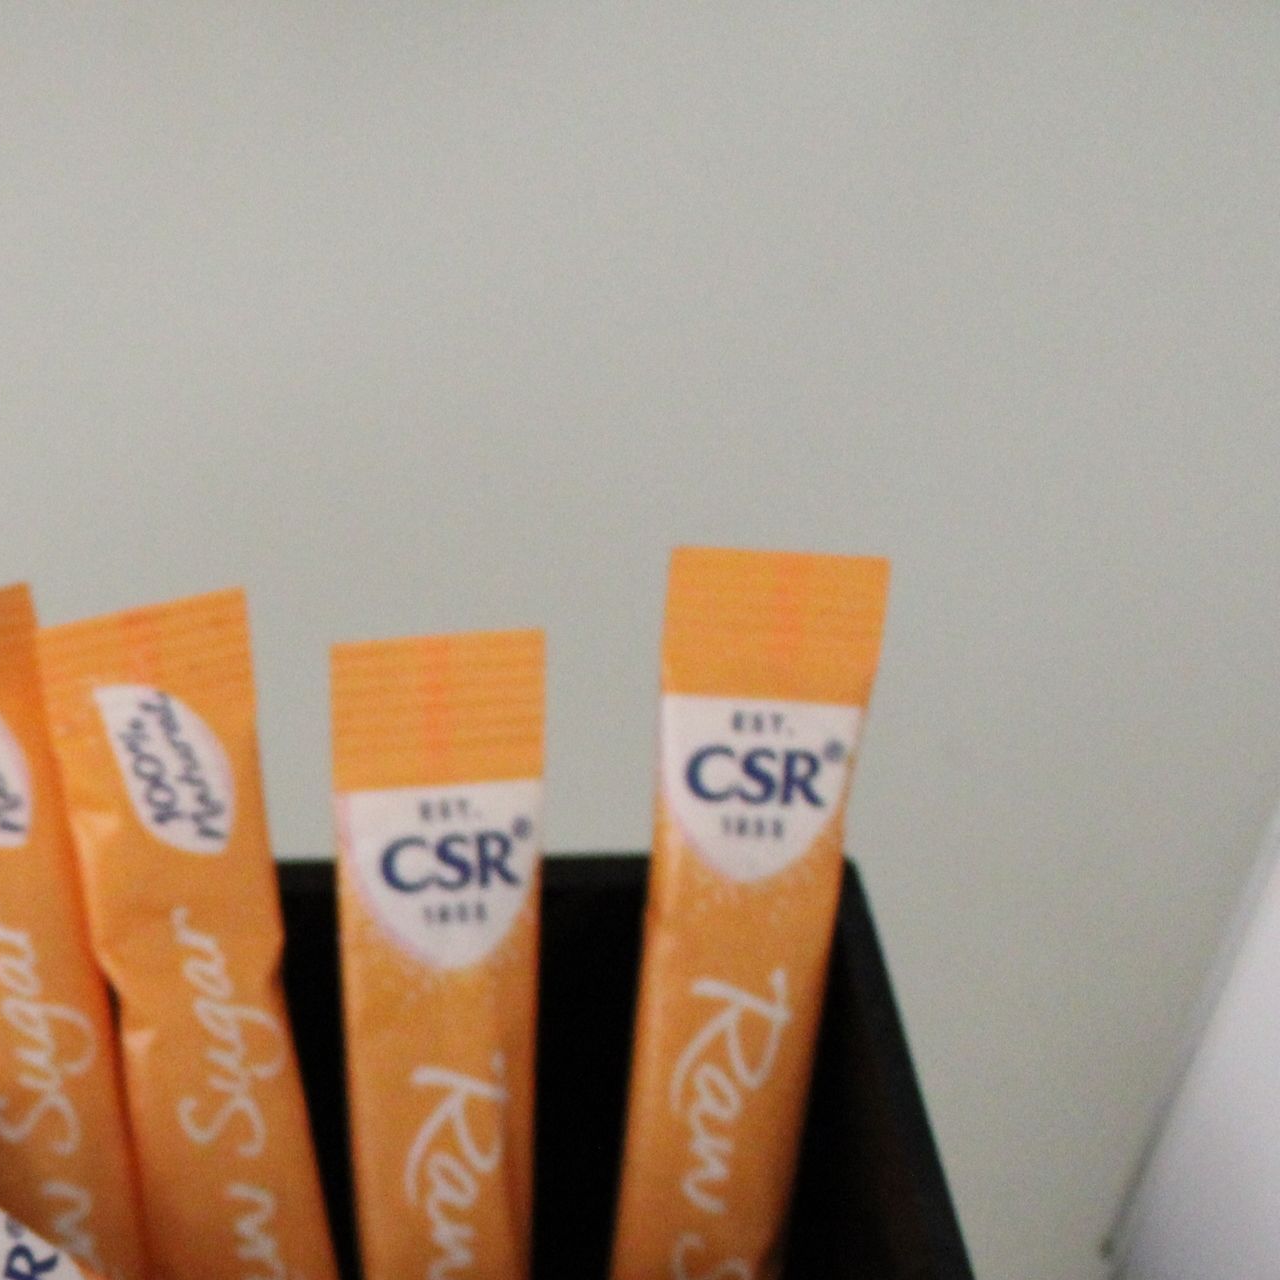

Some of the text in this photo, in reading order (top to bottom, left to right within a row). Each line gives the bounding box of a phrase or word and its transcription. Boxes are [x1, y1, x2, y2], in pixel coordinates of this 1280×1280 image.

[120, 716, 177, 824] 100%
[683, 744, 826, 808] CSR
[380, 830, 521, 893] CSR
[169, 906, 287, 1158] Sugar
[671, 968, 793, 1213] Raw
